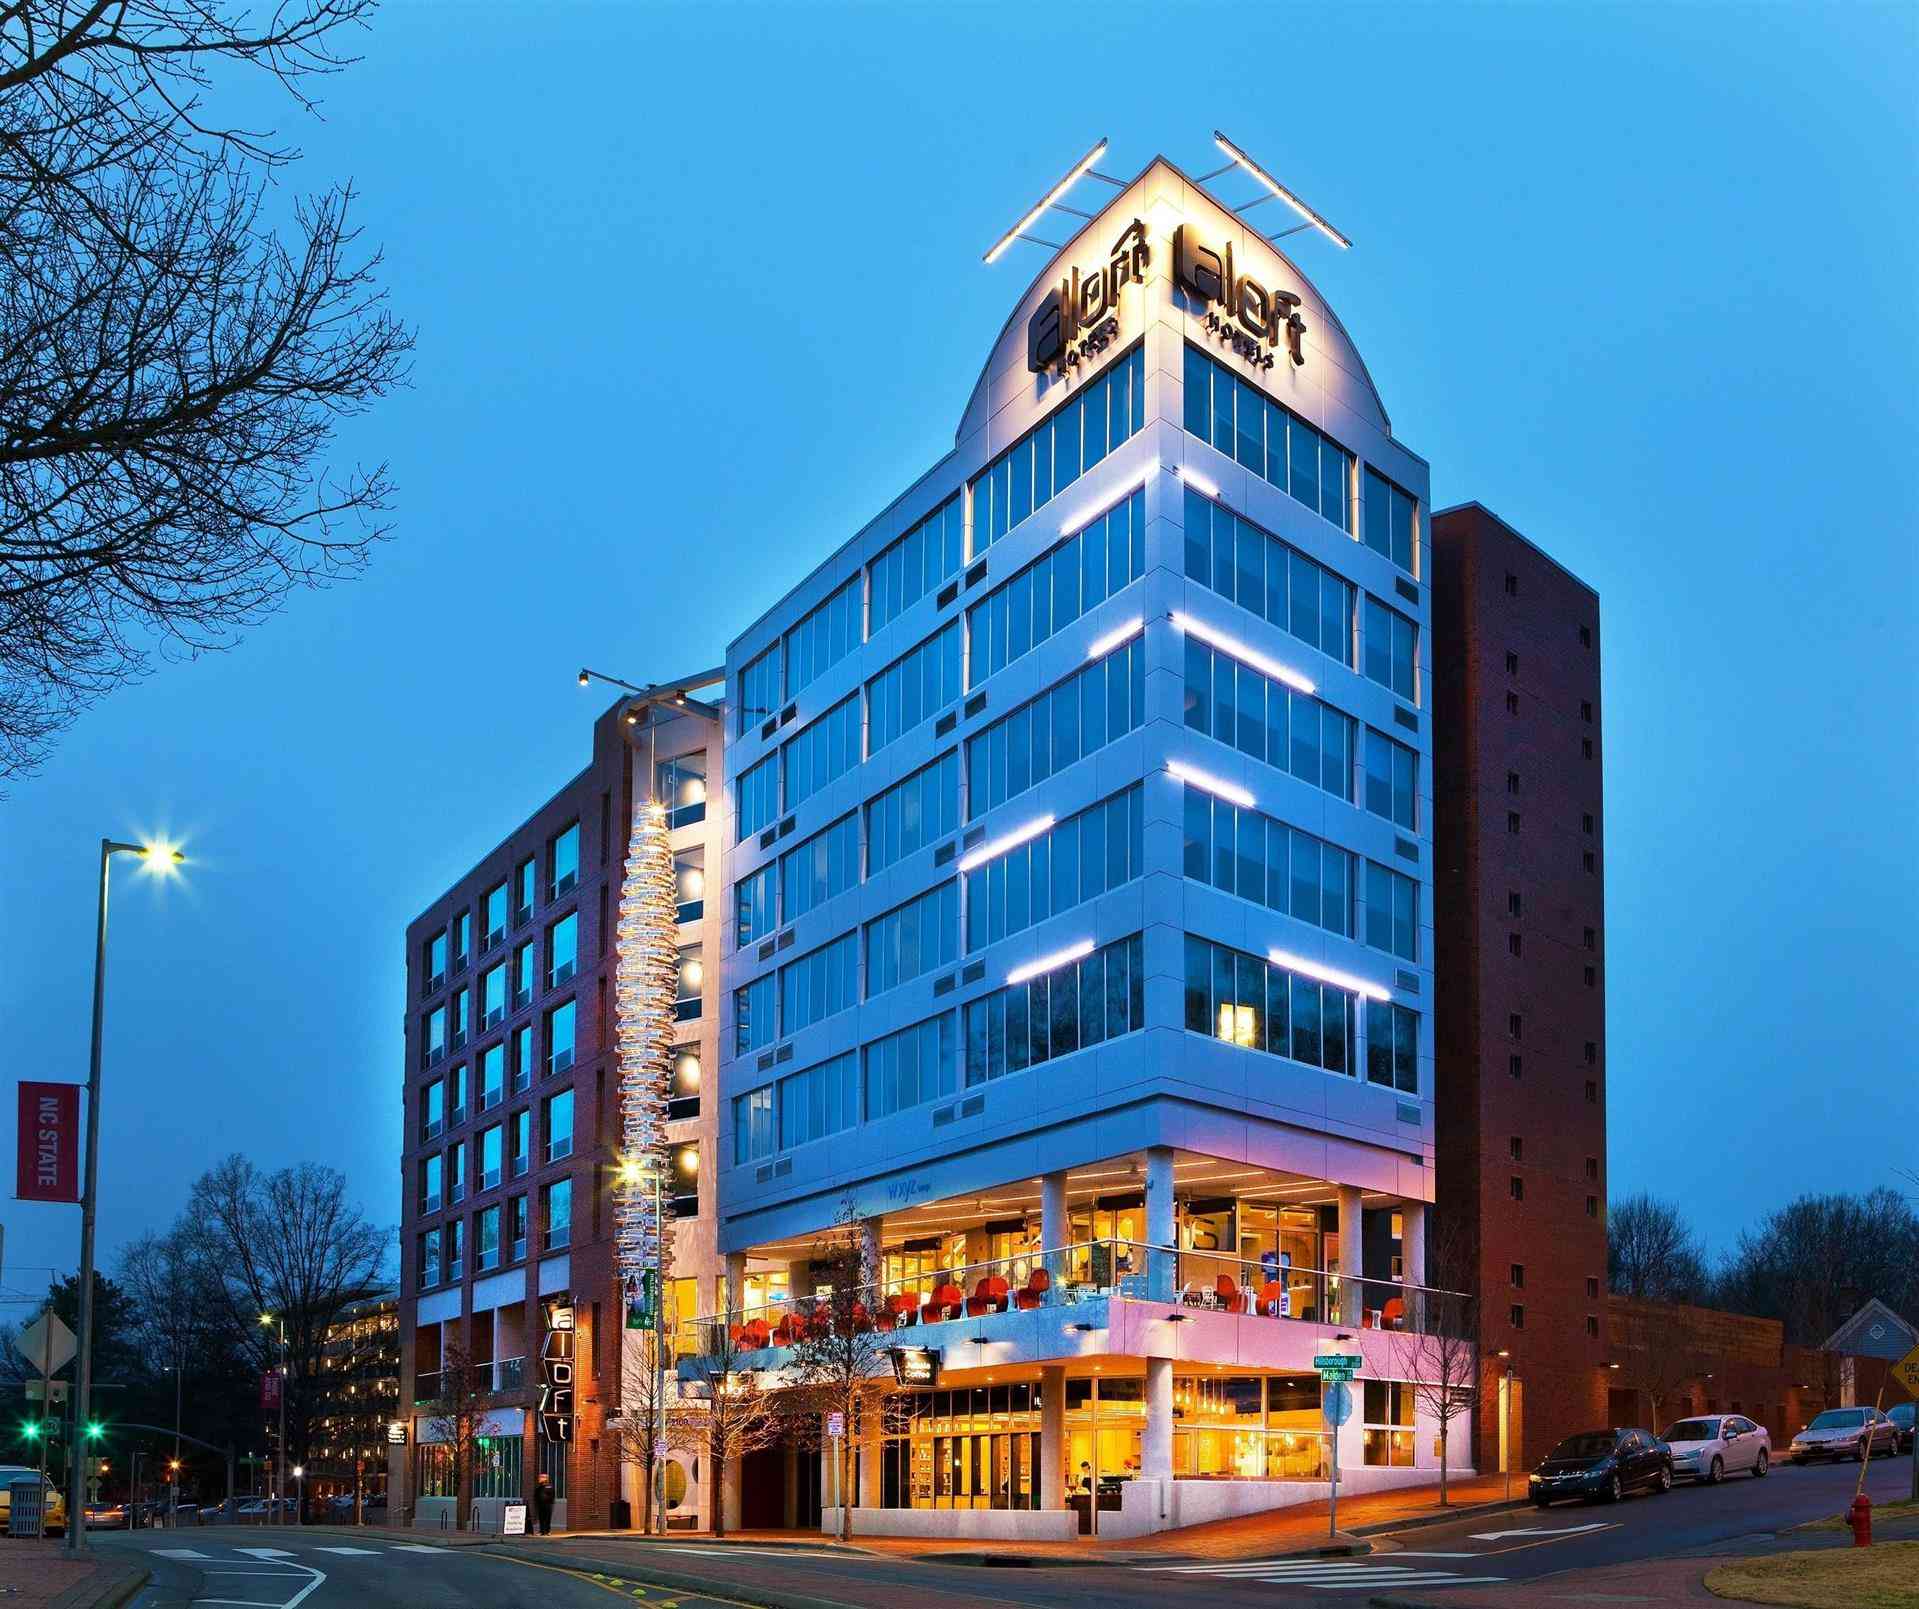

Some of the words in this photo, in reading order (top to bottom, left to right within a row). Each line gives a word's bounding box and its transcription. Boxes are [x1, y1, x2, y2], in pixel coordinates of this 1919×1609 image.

[1028, 217, 1150, 373] aloft
[1173, 223, 1307, 367] aloft
[37, 1130, 58, 1186] STATE
[38, 1096, 58, 1123] NC
[550, 1307, 573, 1440] aloft
